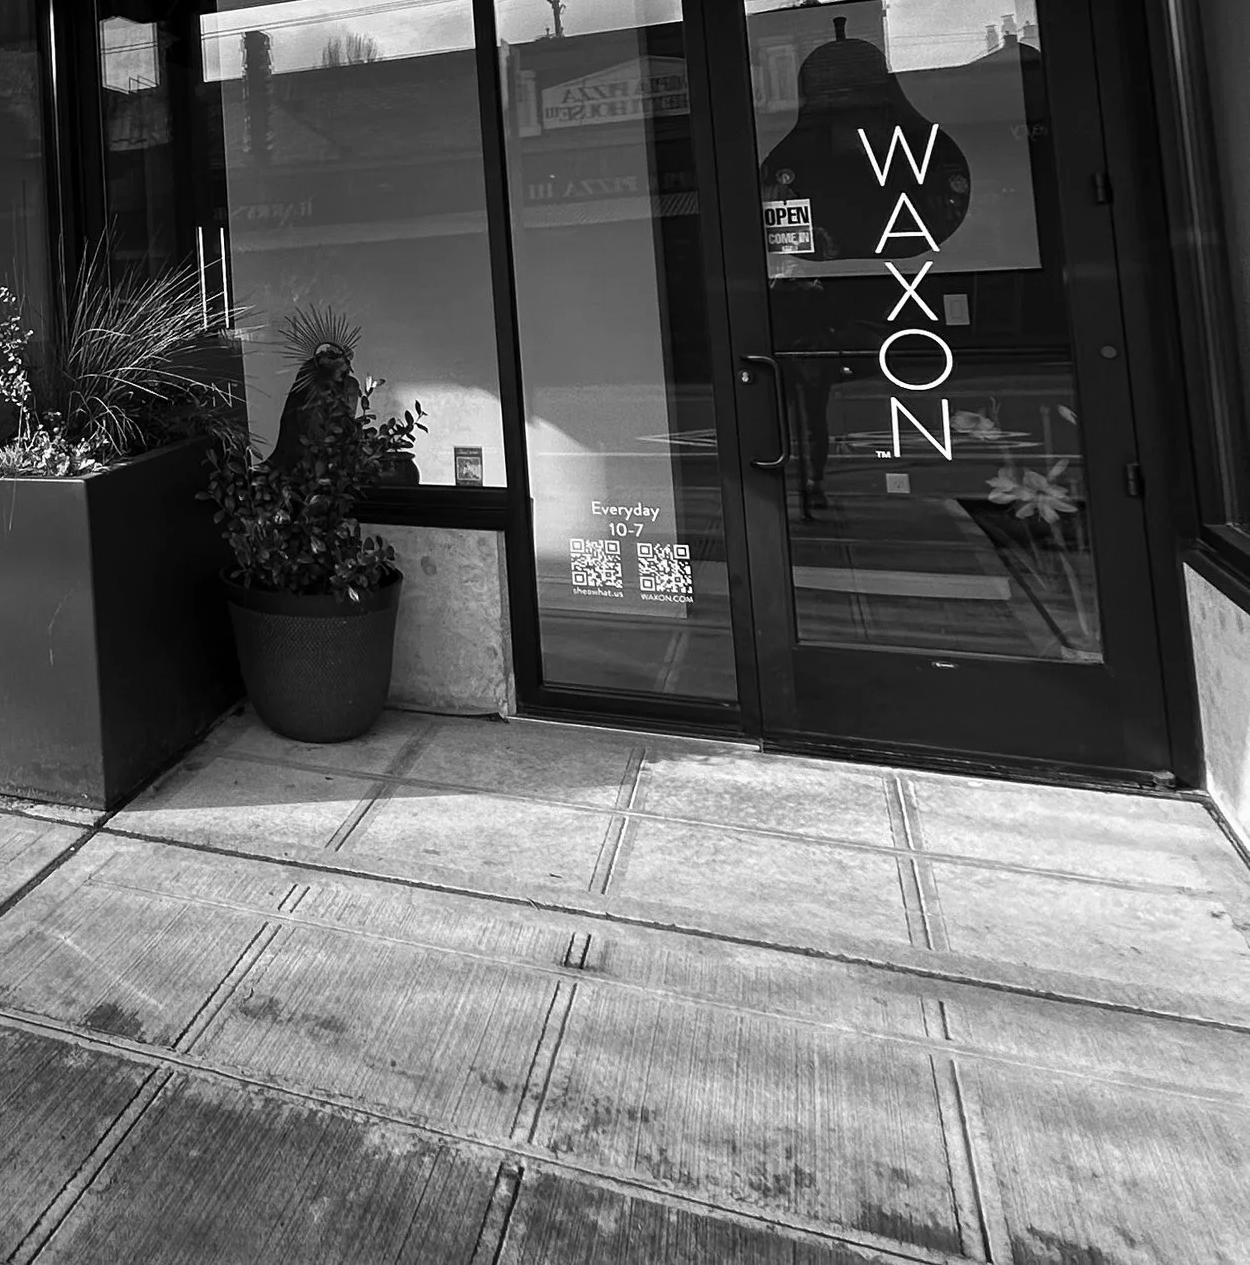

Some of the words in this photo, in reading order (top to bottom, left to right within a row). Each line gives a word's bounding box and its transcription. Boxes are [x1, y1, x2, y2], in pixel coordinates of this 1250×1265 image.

[764, 206, 810, 226] OPEN
[768, 232, 797, 245] COME
[798, 231, 810, 243] IN
[857, 124, 954, 460] WAXON
[591, 501, 660, 522] Everyday
[609, 522, 644, 538] 10-7
[641, 593, 694, 603] WAXON.COM
